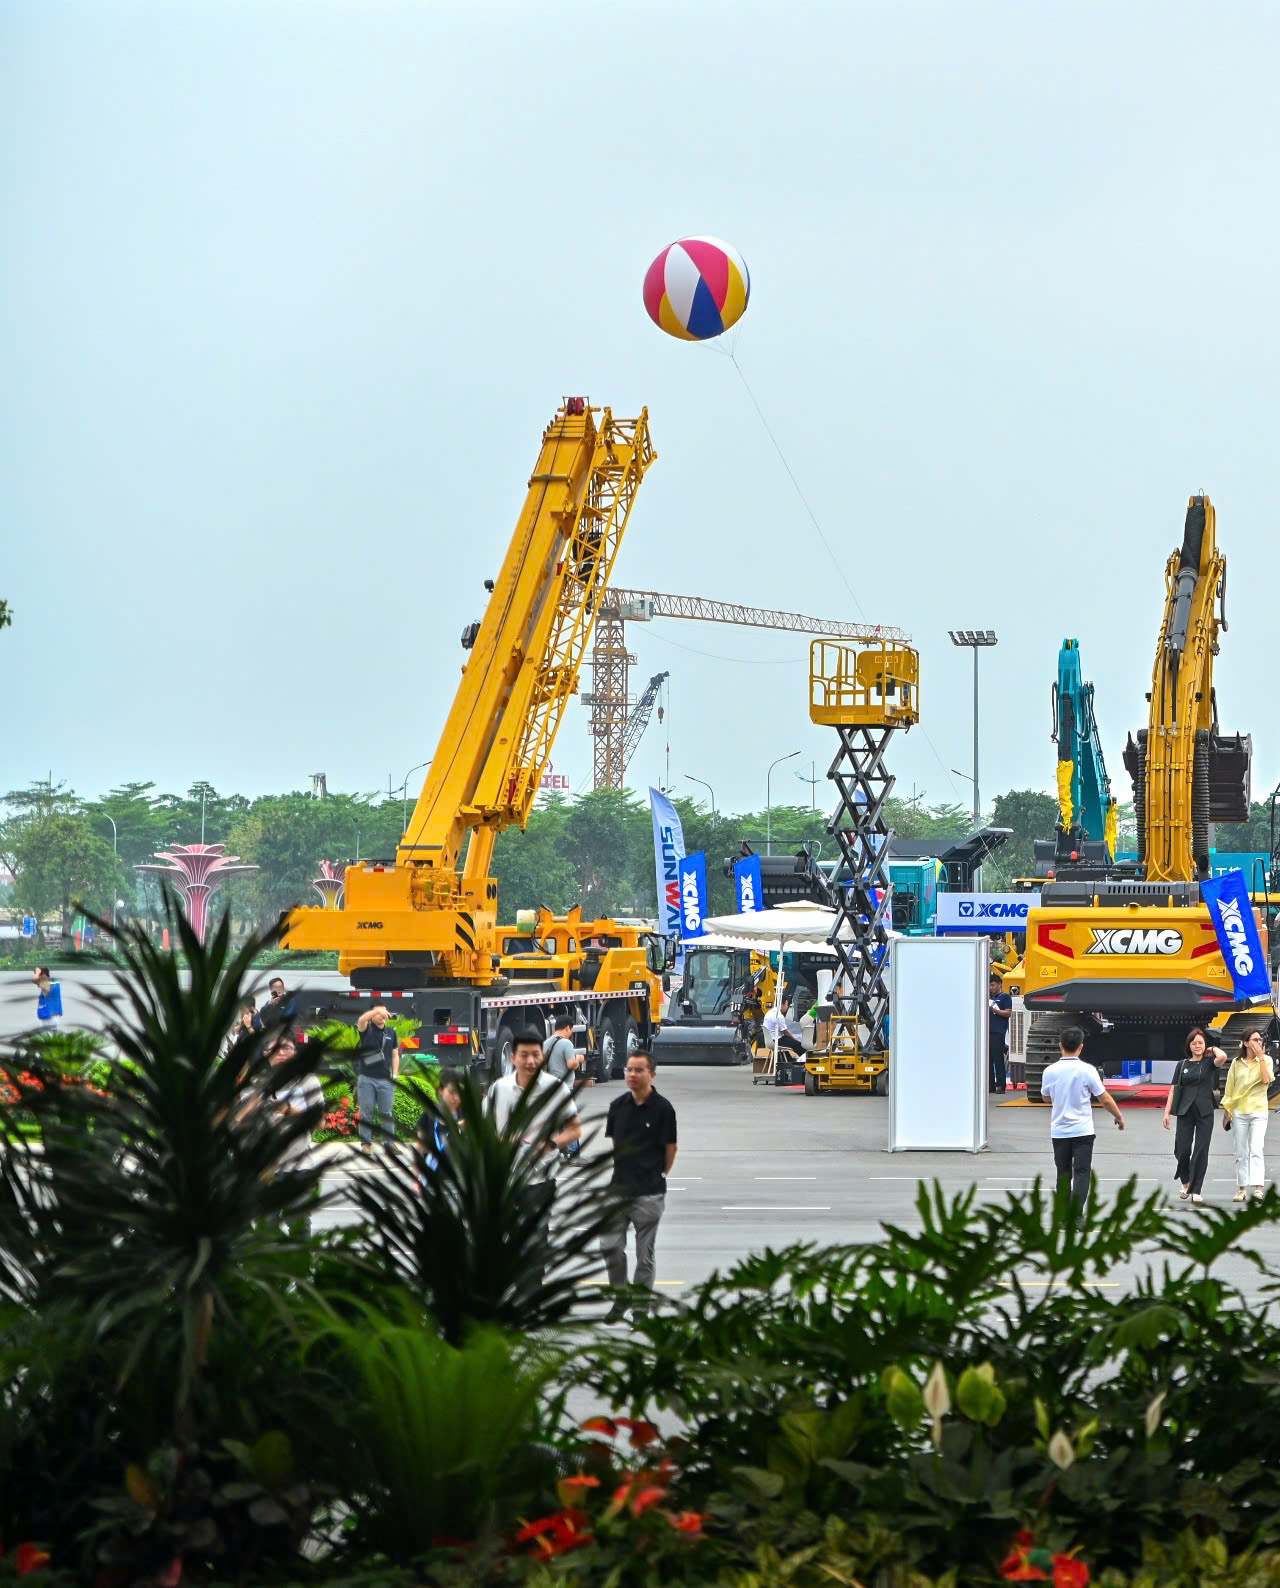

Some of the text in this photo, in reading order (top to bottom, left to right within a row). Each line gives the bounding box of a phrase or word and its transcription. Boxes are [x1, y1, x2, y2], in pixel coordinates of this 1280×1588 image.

[682, 871, 701, 931] XCMG
[740, 874, 755, 913] XCM
[356, 921, 384, 930] XCMG
[975, 903, 1029, 918] XCMG
[1081, 928, 1184, 954] XCMG
[1216, 898, 1253, 976] XCMG
